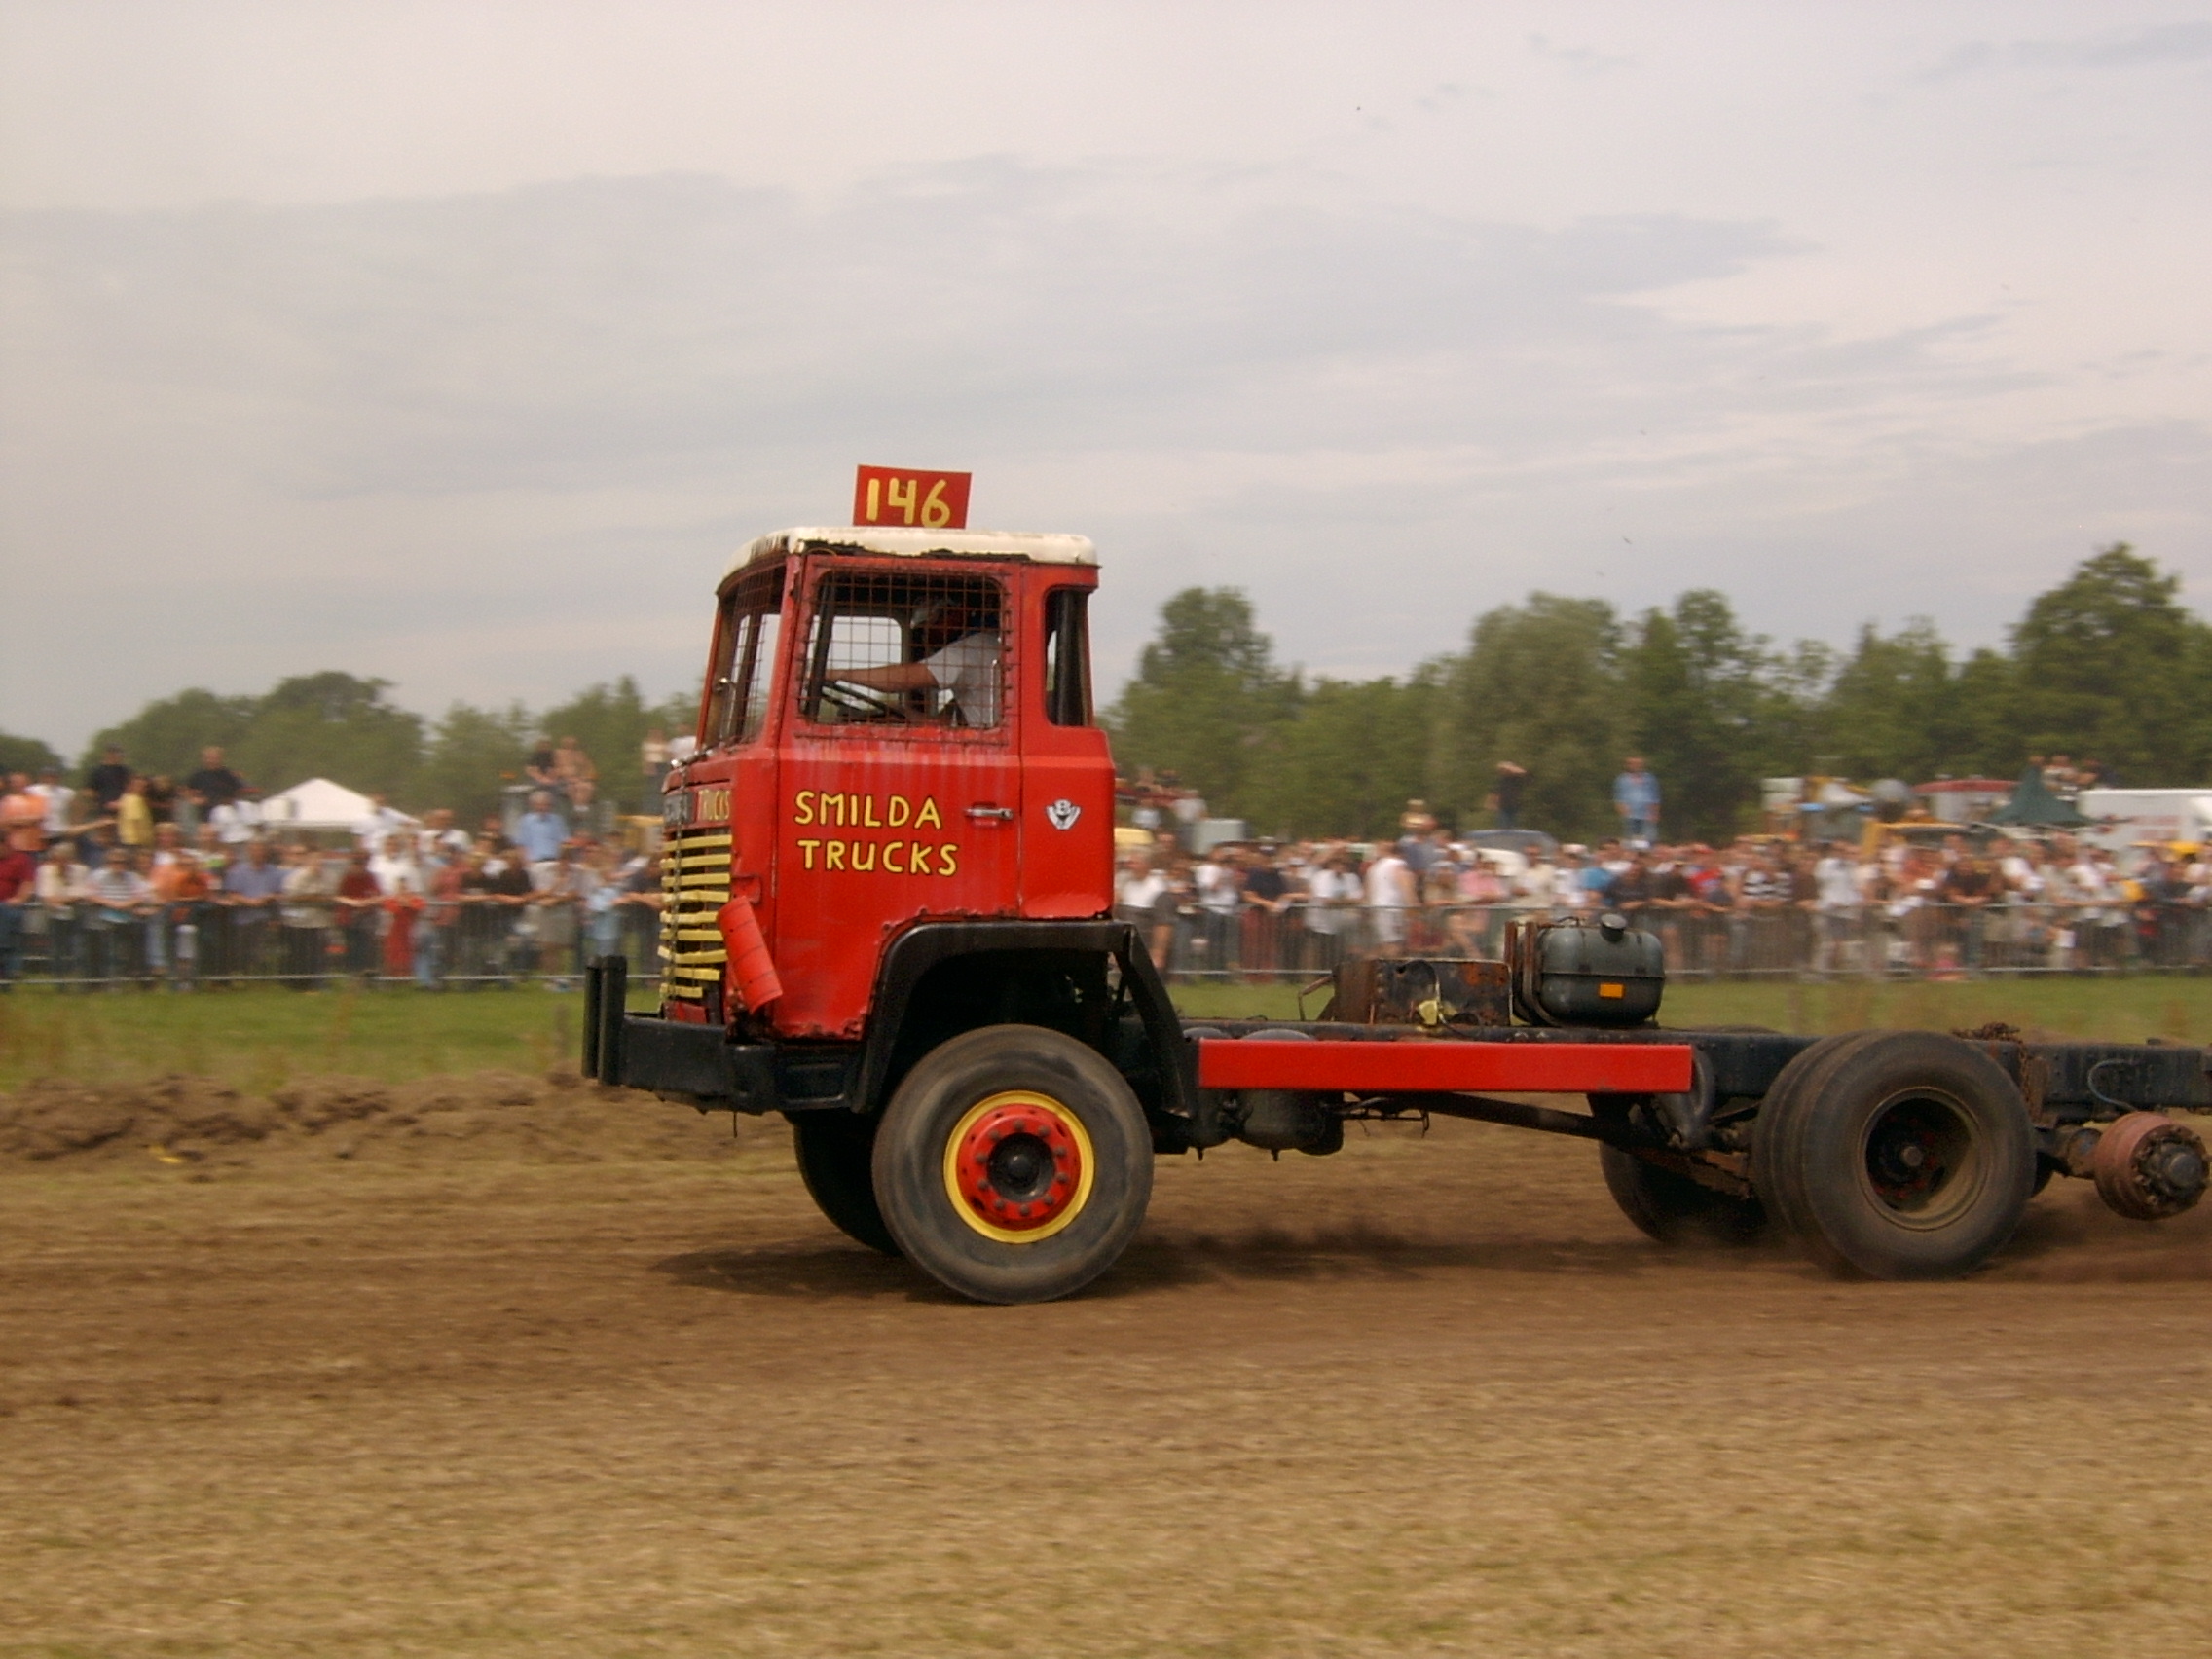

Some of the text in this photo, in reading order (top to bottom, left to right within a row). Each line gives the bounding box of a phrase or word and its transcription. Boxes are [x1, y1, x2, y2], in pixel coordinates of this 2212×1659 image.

[865, 477, 951, 529] 146
[794, 790, 941, 829] SMILDA
[797, 839, 959, 876] TRUCKS
